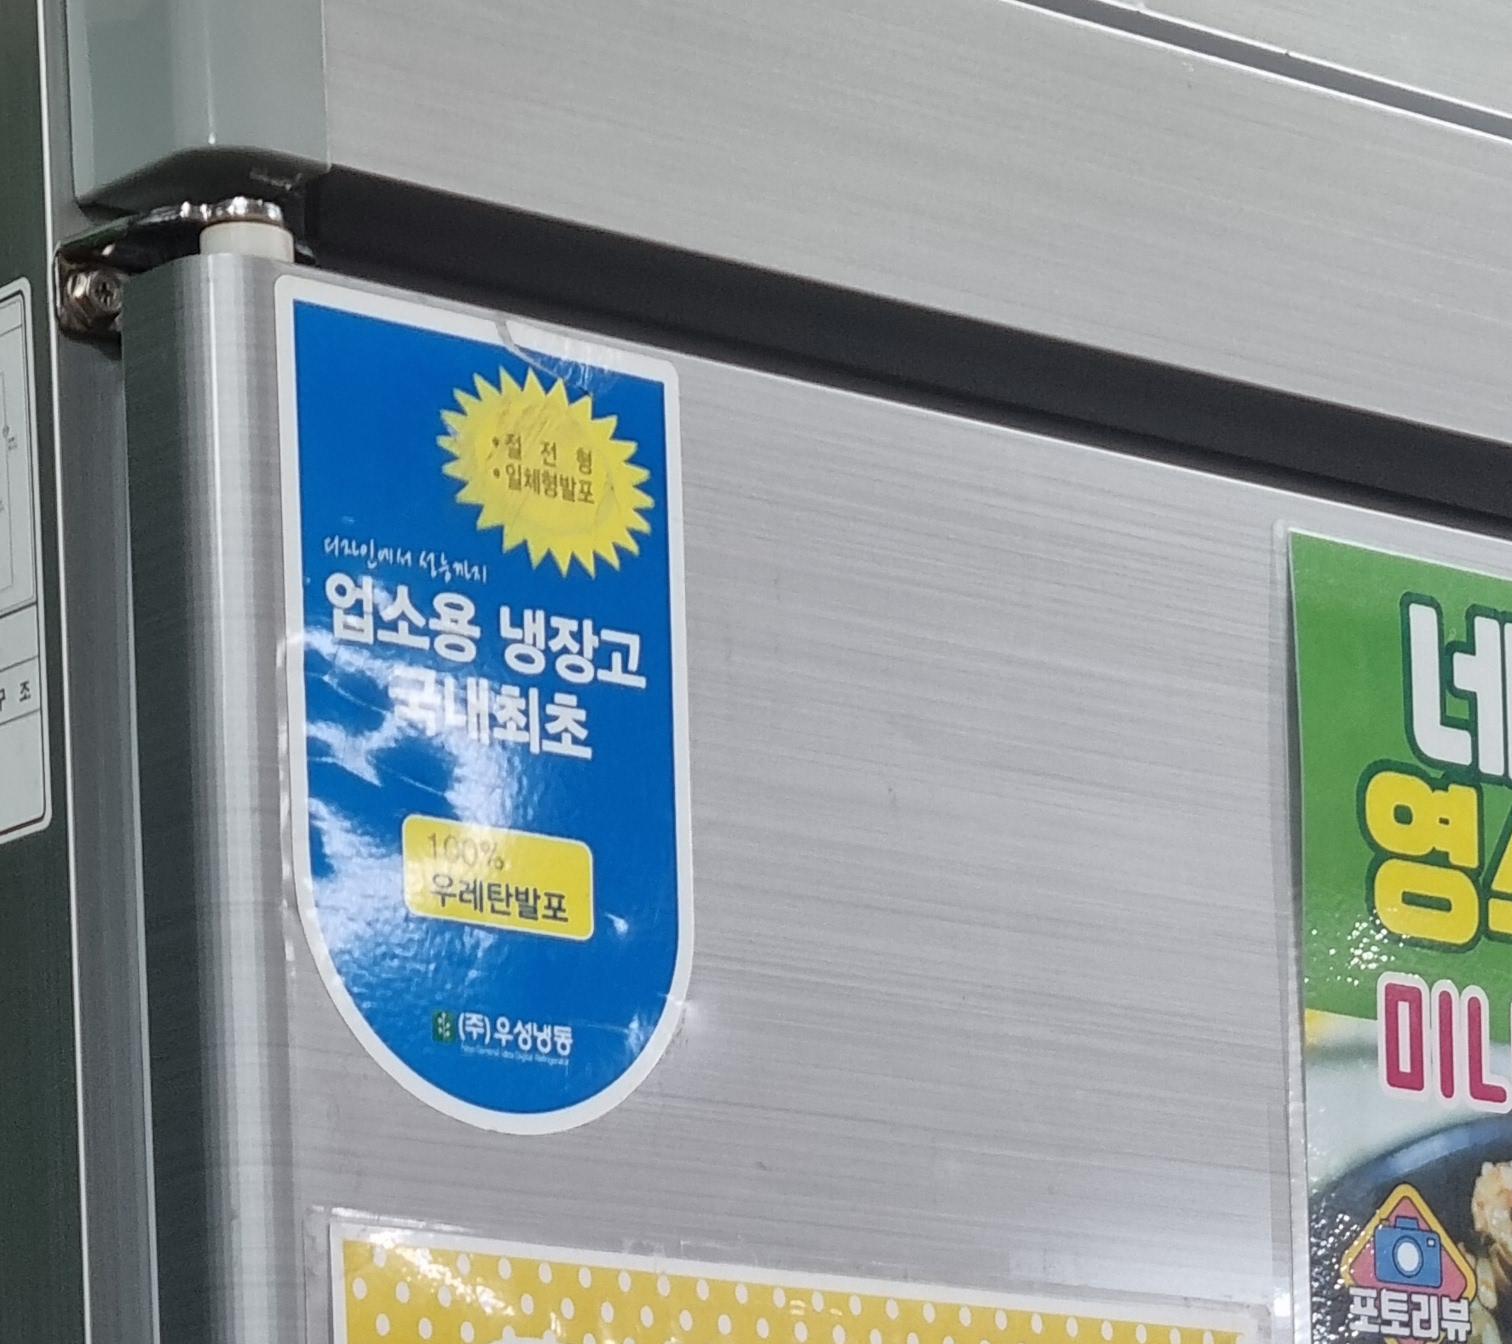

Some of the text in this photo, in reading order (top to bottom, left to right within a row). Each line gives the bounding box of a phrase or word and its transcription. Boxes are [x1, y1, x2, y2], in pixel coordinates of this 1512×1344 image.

[505, 464, 595, 505] 일체형발포
[325, 572, 647, 690] 업소용 냉장고
[388, 664, 593, 760] 국내최초
[427, 832, 505, 871] 100%
[432, 873, 569, 923] 우레탄발포
[1347, 1286, 1471, 1342] 포토리뷰
